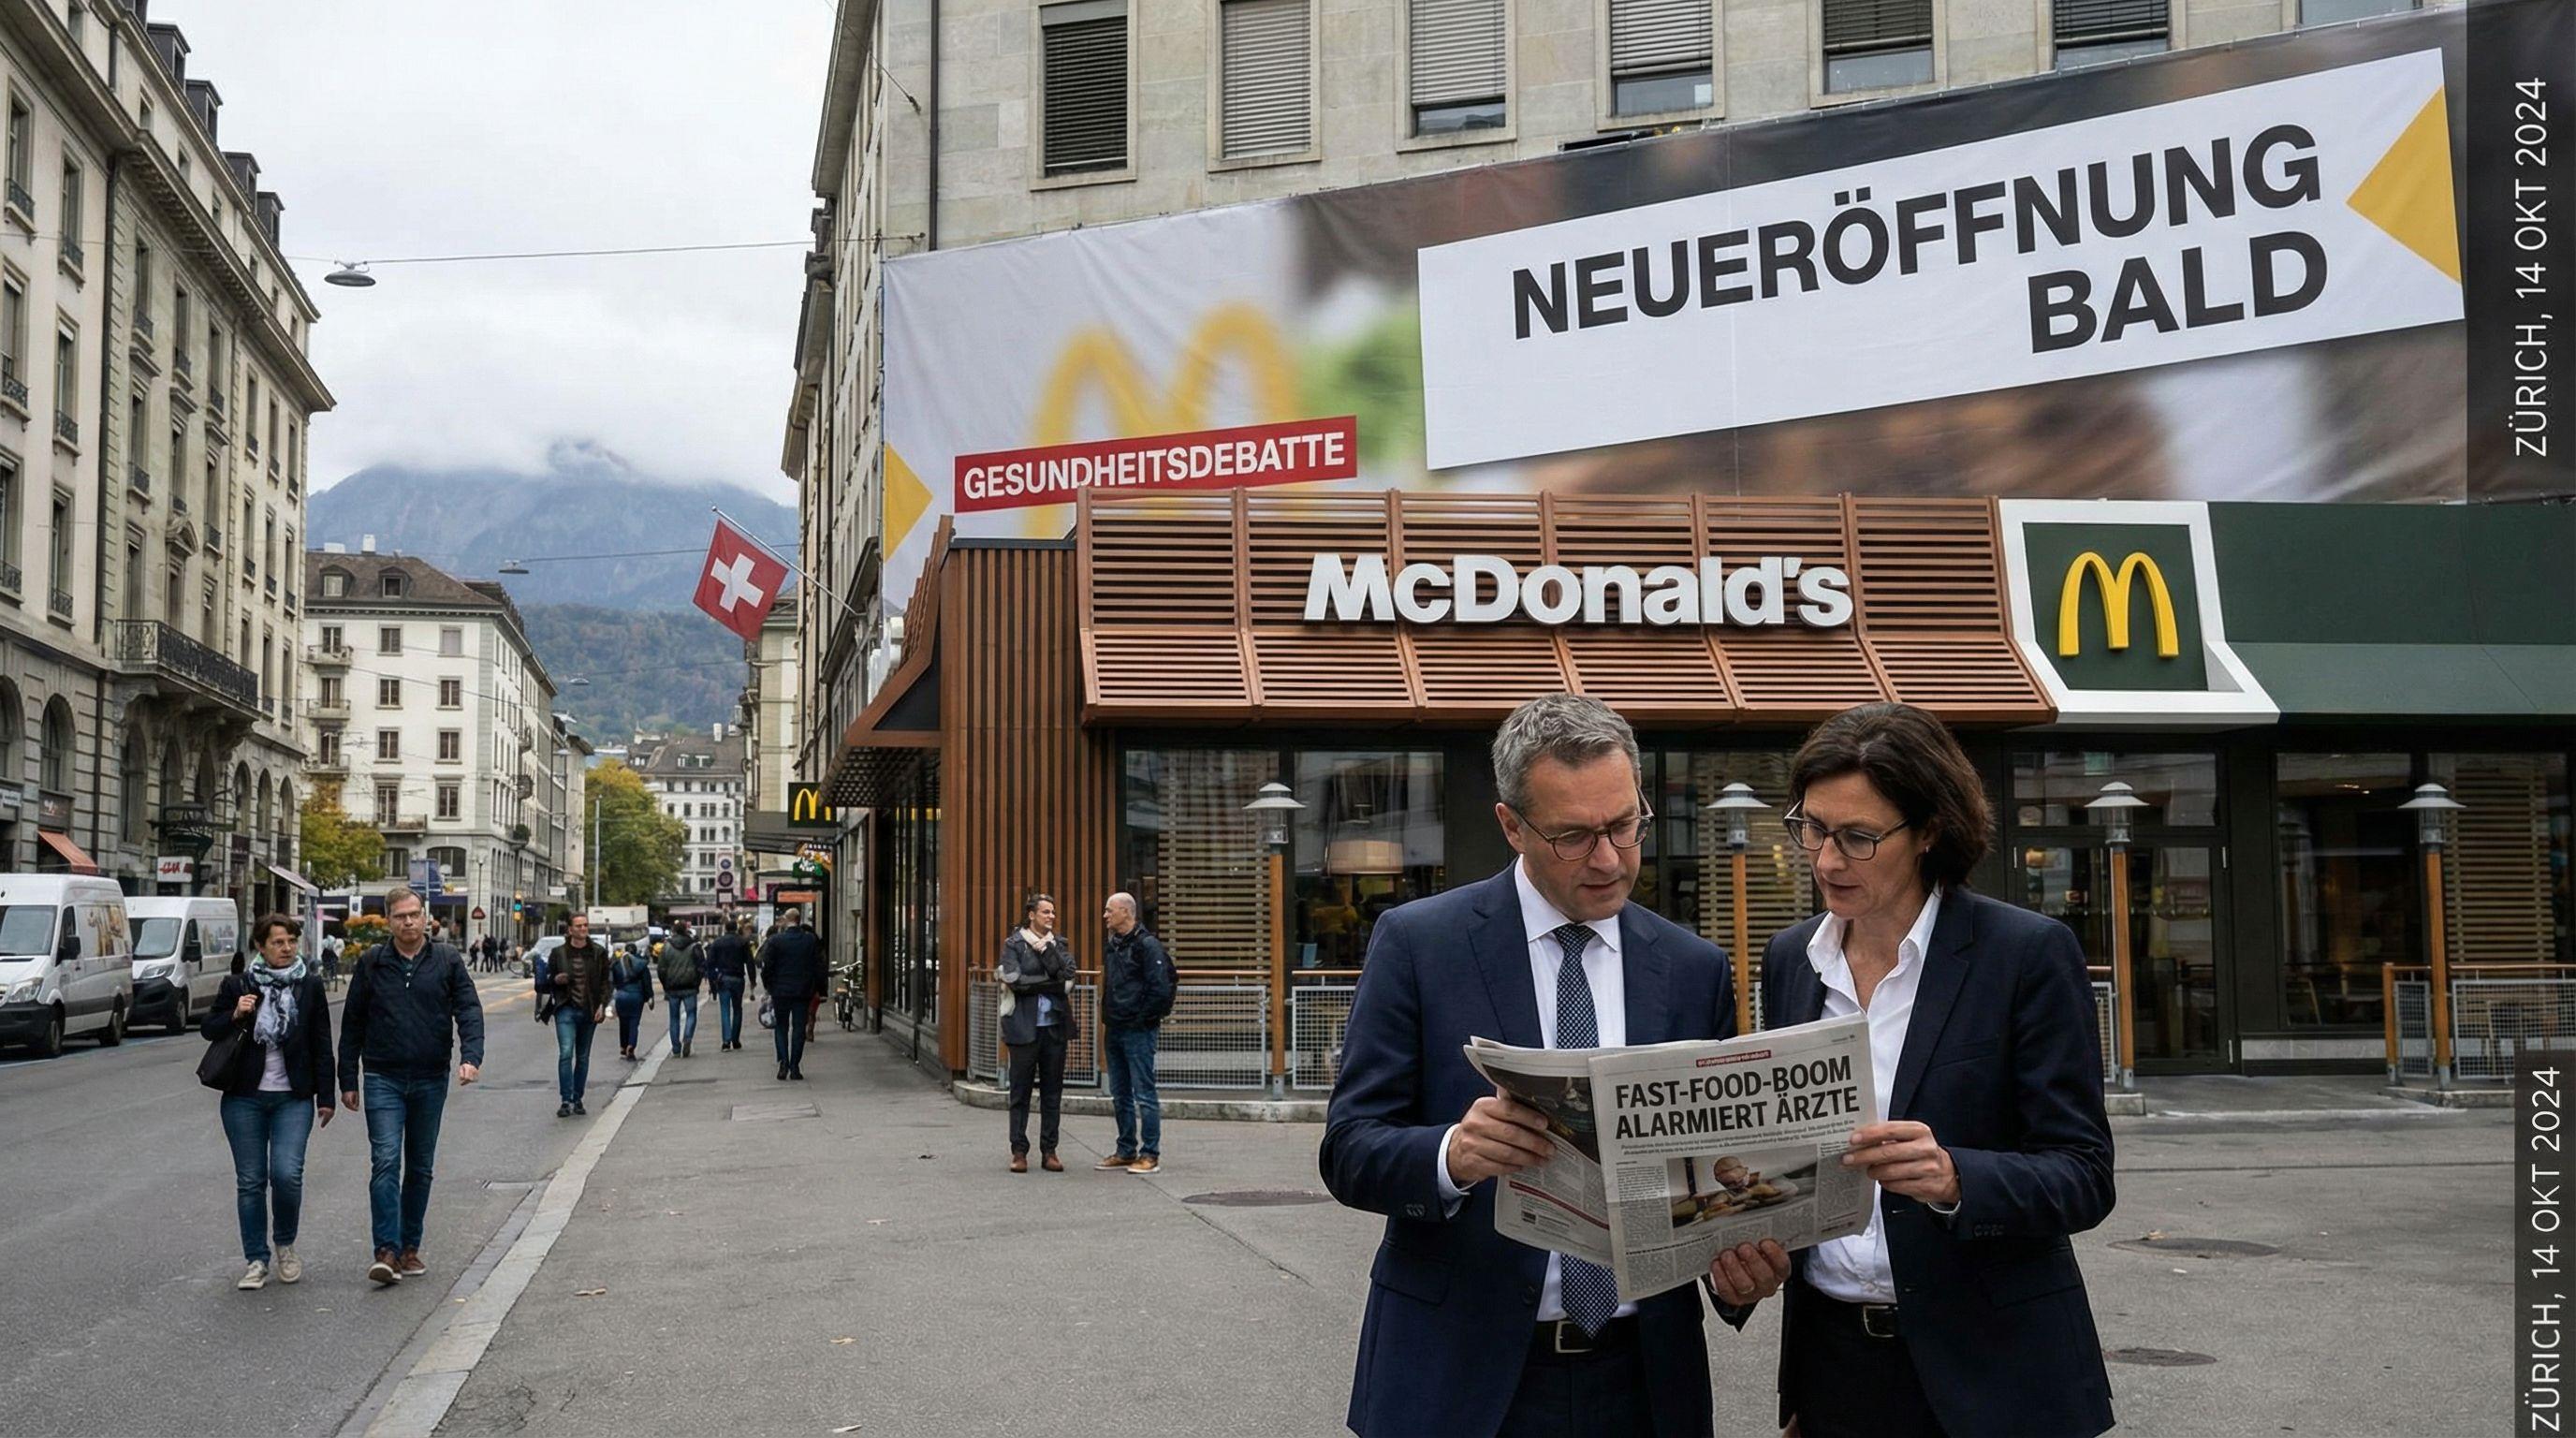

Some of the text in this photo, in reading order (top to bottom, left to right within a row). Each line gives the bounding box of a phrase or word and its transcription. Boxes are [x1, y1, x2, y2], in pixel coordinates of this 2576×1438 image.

[1513, 124, 2320, 340] NEUERÖFFNUNG
[2027, 230, 2328, 354] BALD
[963, 432, 1345, 500] GESUNDHEITSDEBATTE
[1303, 553, 1854, 626] McDonald's
[1616, 1055, 1852, 1109] FAST-FOOD-BOOM
[1616, 1101, 1768, 1140] ALARMIERT
[1776, 1086, 1860, 1124] ÄRZTE
